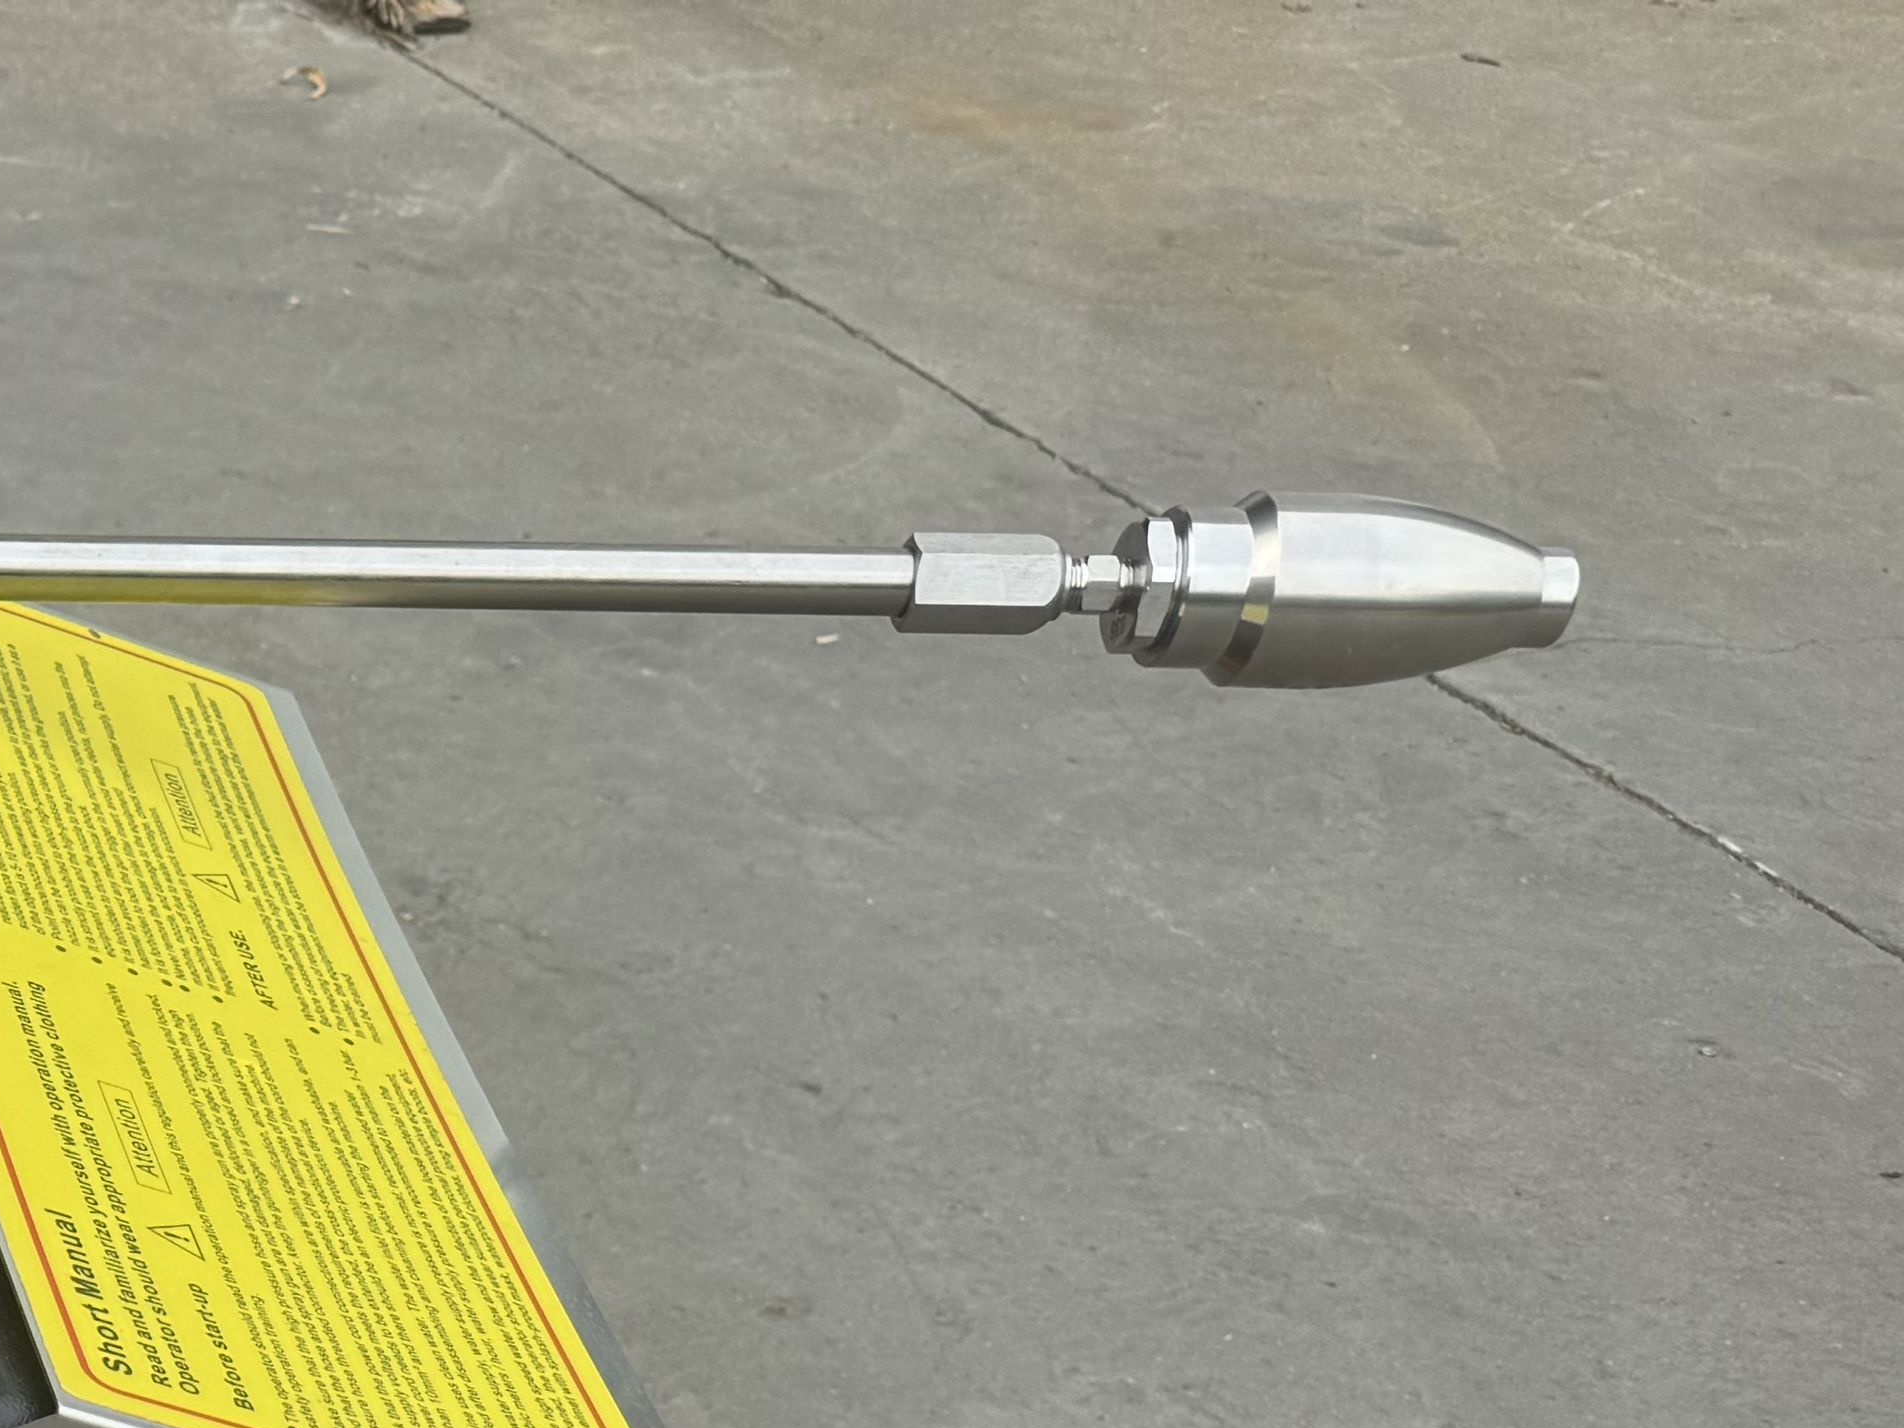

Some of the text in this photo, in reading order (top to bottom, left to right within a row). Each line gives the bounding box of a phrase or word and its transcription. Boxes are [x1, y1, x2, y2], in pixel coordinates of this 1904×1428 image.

[164, 772, 201, 836] Attention
[228, 929, 277, 1010] AFTER USE.
[114, 1098, 158, 1177] Attention
[1, 981, 171, 1387] Read and familiarize yourself with operation manual.
[27, 980, 199, 1394] Operator should wear appropriate protective clothing
[105, 982, 299, 1422] The operator should read the operation manual and this regulation carefully and receive
[314, 1153, 347, 1205] protection
[337, 1205, 363, 1244] electric
[356, 1245, 370, 1259] an
[45, 1208, 132, 1375] Short Manual
[363, 1260, 378, 1274] be
[368, 1274, 396, 1312] should
[188, 1283, 254, 1411] Before start-up
[389, 1313, 411, 1342] there
[402, 1342, 422, 1365] and
[270, 1338, 302, 1392] operation
